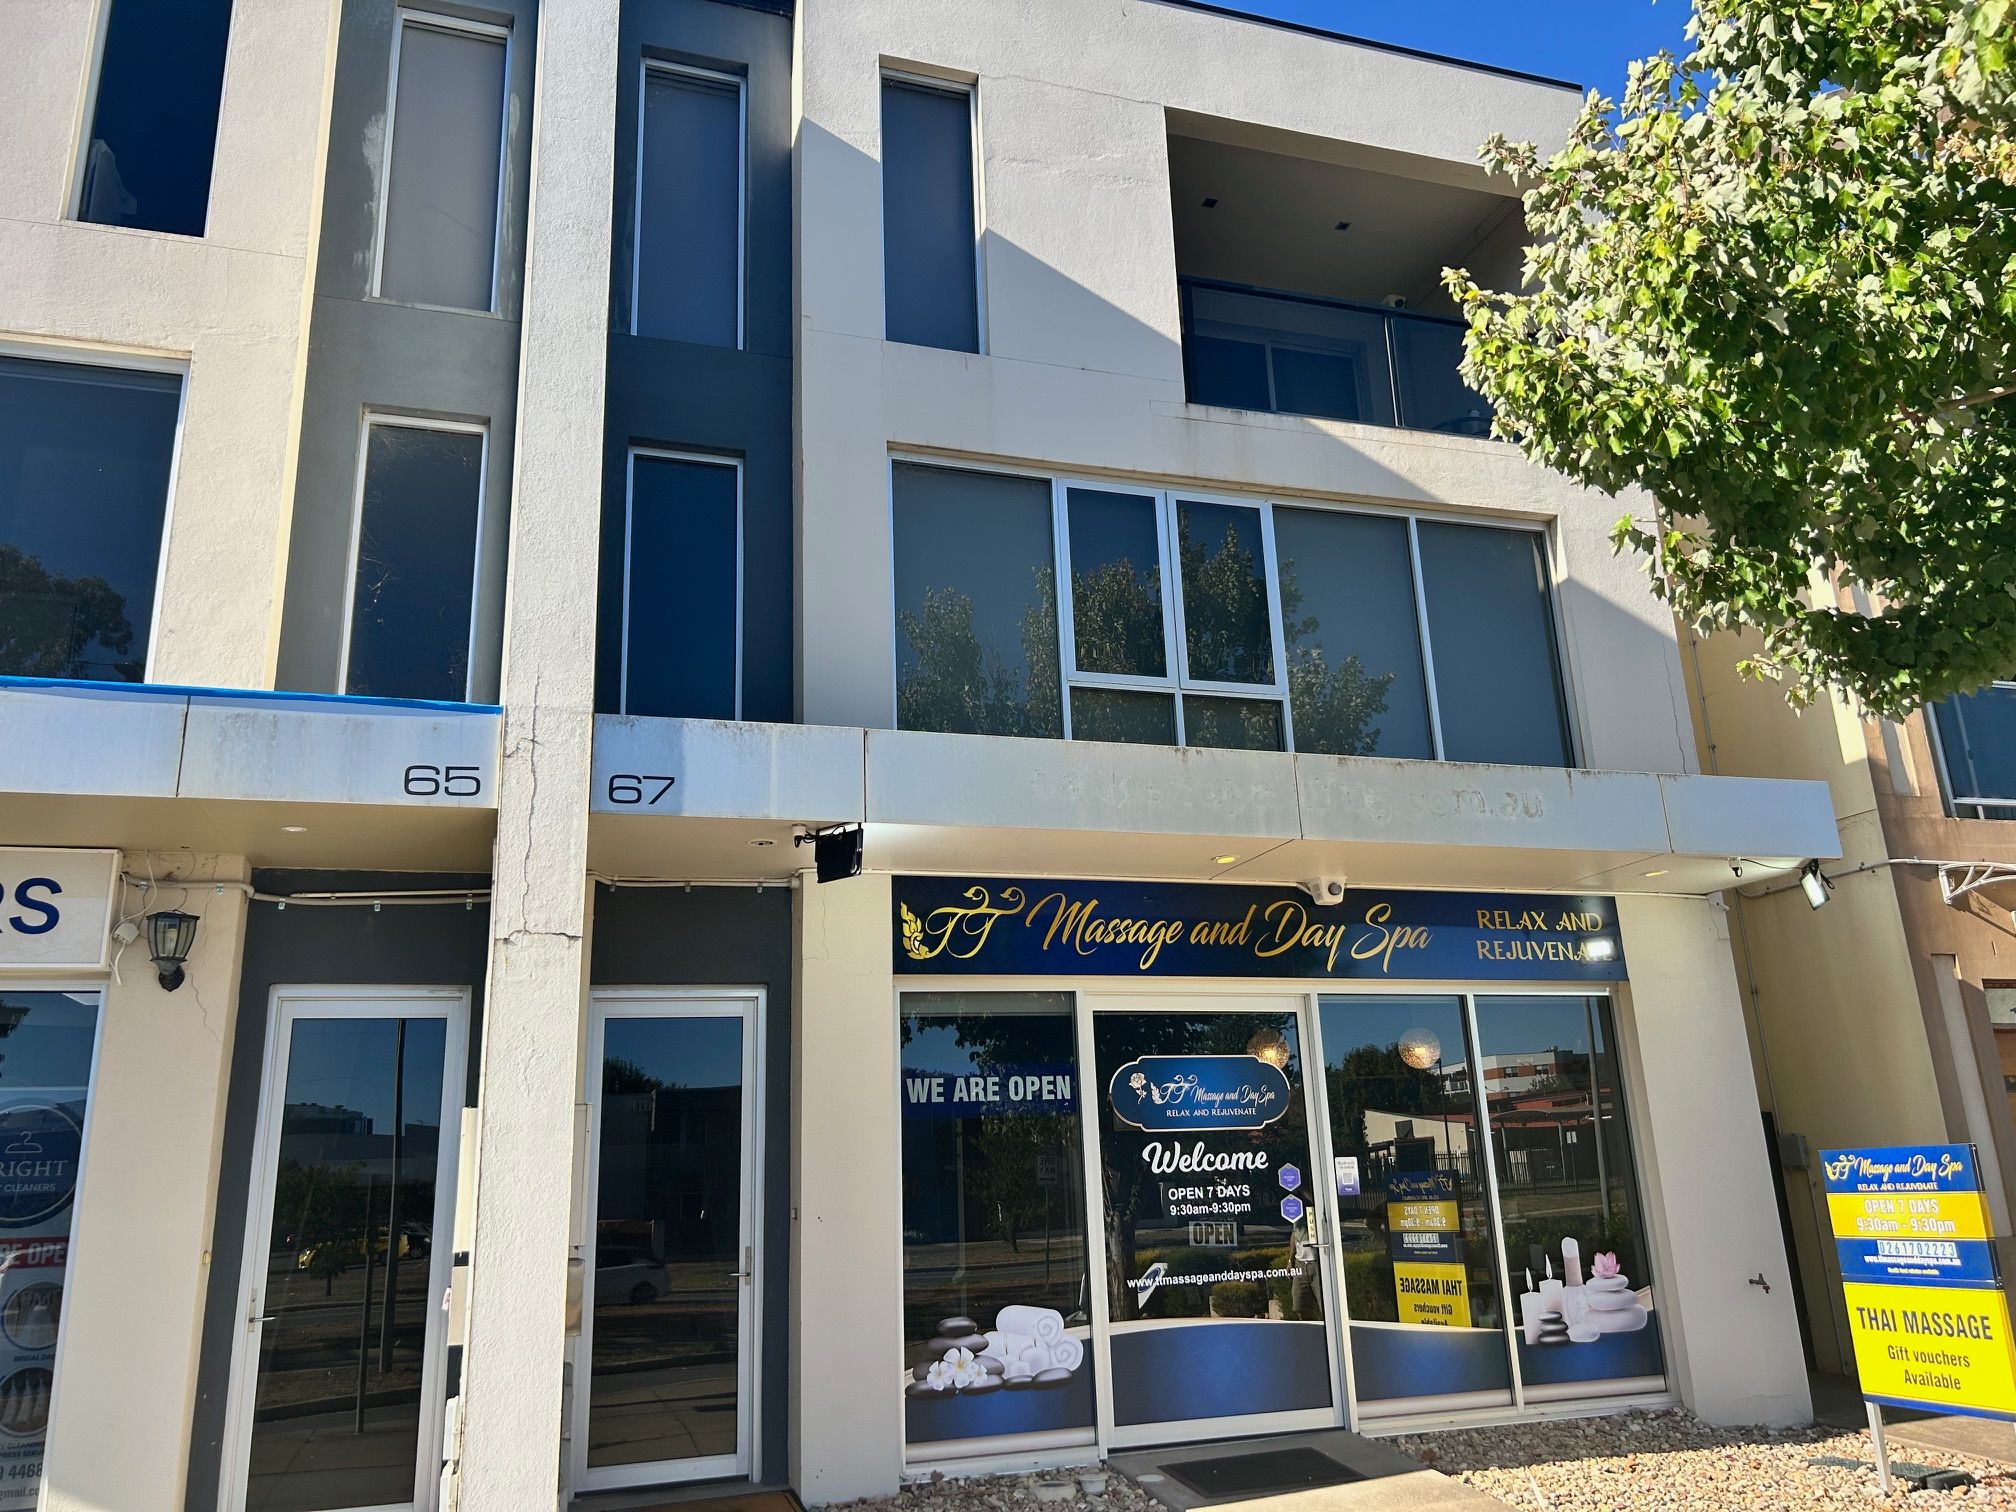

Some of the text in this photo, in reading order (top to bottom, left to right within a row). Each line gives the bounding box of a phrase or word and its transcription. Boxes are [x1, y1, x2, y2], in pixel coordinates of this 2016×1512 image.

[403, 765, 481, 797] 65
[608, 774, 675, 805] 67
[0, 876, 63, 935] S
[1476, 909, 1603, 932] RELAX AND
[1026, 892, 1184, 970] Massage
[1190, 904, 1258, 946] and
[1255, 900, 1345, 970] Day
[1346, 903, 1434, 973] Spa
[1476, 939, 1613, 962] REJUVENA
[906, 1075, 1071, 1104] WE ARE OPEN
[1190, 1085, 1224, 1108] Massage
[1224, 1087, 1239, 1101] and
[1240, 1085, 1260, 1108] Day
[1258, 1085, 1276, 1108] Spa
[1166, 1107, 1257, 1118] RELAX AND REJUVENATE
[1141, 1141, 1270, 1175] Welcome
[1854, 1157, 1893, 1183] Massage
[1894, 1157, 1911, 1174] and
[1911, 1154, 1937, 1182] Day
[1938, 1154, 1963, 1181] Spa
[4, 1183, 57, 1192] CLEANERS
[1168, 1184, 1251, 1201] OPEN 7 DAYS
[1857, 1183, 1879, 1191] RELAX
[1880, 1182, 1895, 1191] AND
[1169, 1202, 1252, 1216] 9:30am-9:30pm
[1864, 1199, 1940, 1214] OPEN 7 DAYS
[1191, 1222, 1236, 1246] OPEN
[1857, 1217, 1897, 1232] 9:30am
[1910, 1217, 1956, 1234] 9:30pm
[1879, 1241, 1955, 1257] 0261702223
[1127, 1266, 1303, 1290] www.ttmassageanddayspa.com.au
[1857, 1306, 1993, 1340] THAI MASSAGE
[1888, 1345, 1971, 1367] Gift vouchers
[1904, 1369, 1962, 1391] Available
